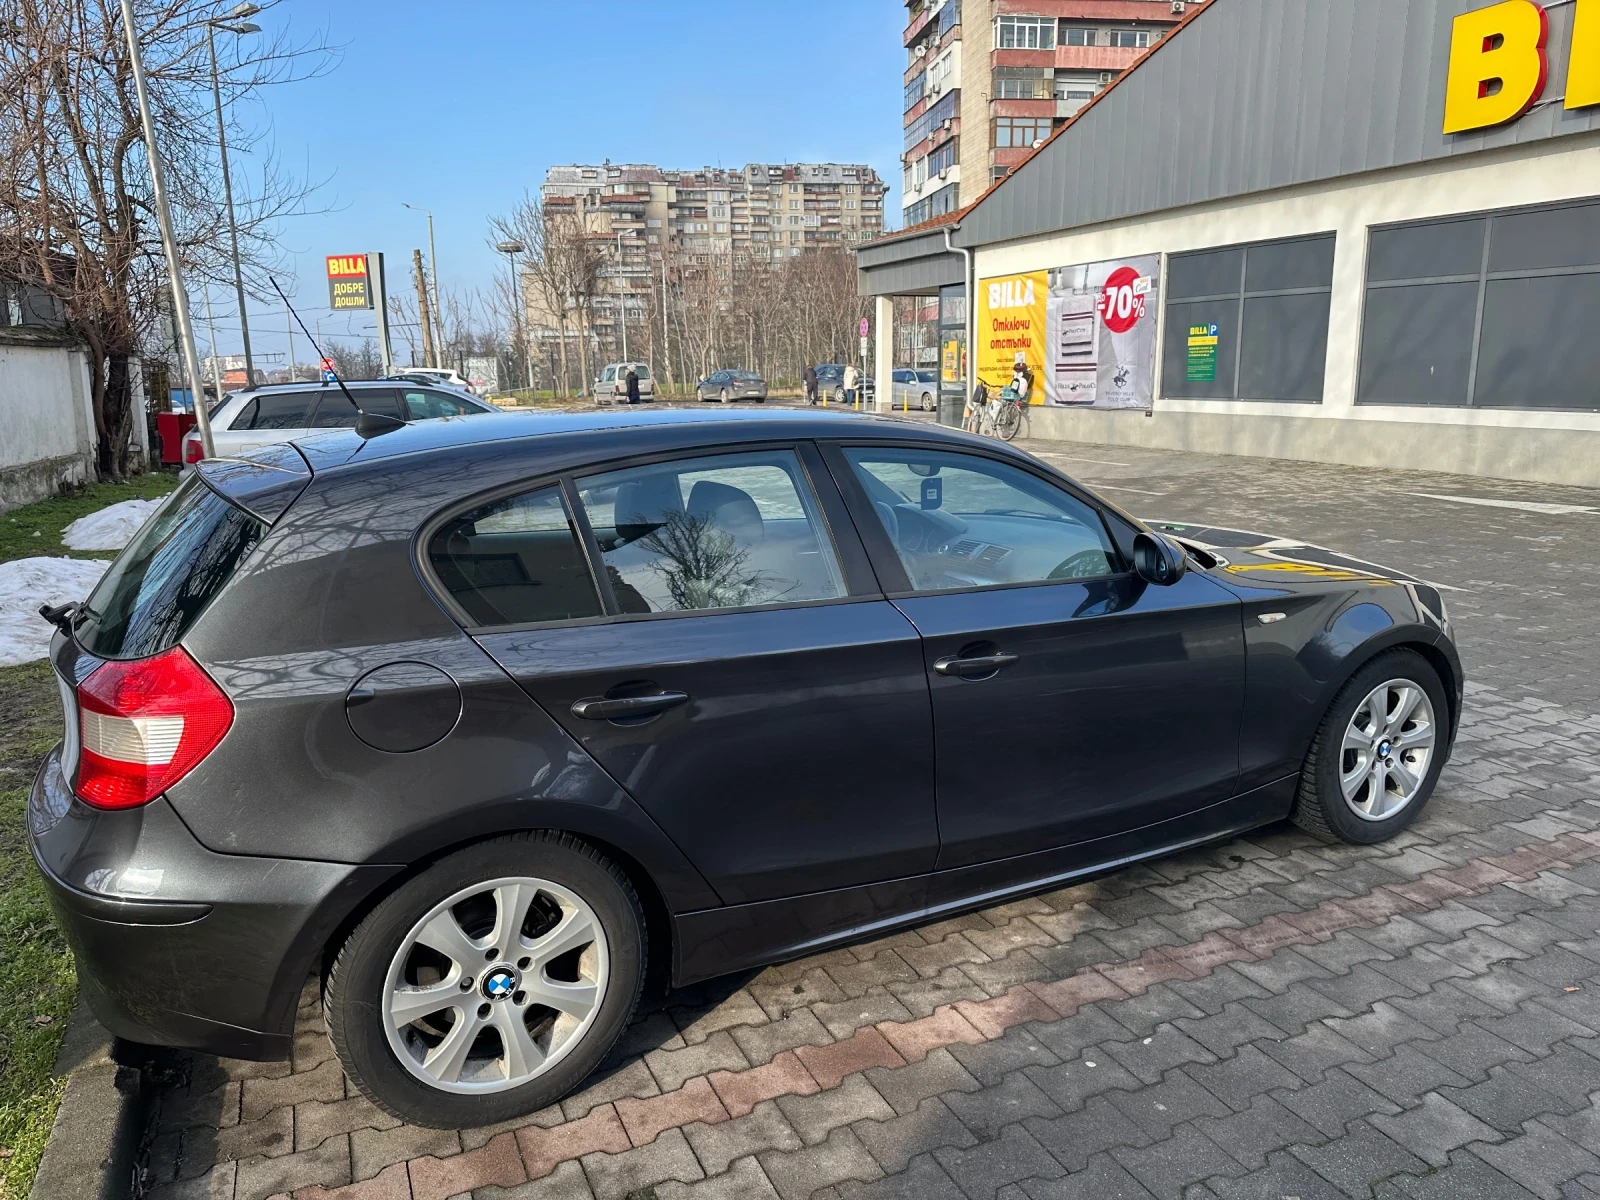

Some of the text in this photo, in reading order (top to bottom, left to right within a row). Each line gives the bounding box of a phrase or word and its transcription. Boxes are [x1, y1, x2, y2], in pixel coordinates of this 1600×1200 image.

[328, 257, 366, 275] BILLA
[333, 282, 365, 296] ДОБРЕ
[989, 279, 1035, 309] BILLA
[335, 296, 365, 308] ДОШЛИ
[1097, 284, 1145, 320] -70%
[992, 315, 1031, 332] Отключи
[1210, 324, 1217, 335] P
[990, 333, 1032, 350] отстъпки
[493, 977, 516, 1001] BMW
